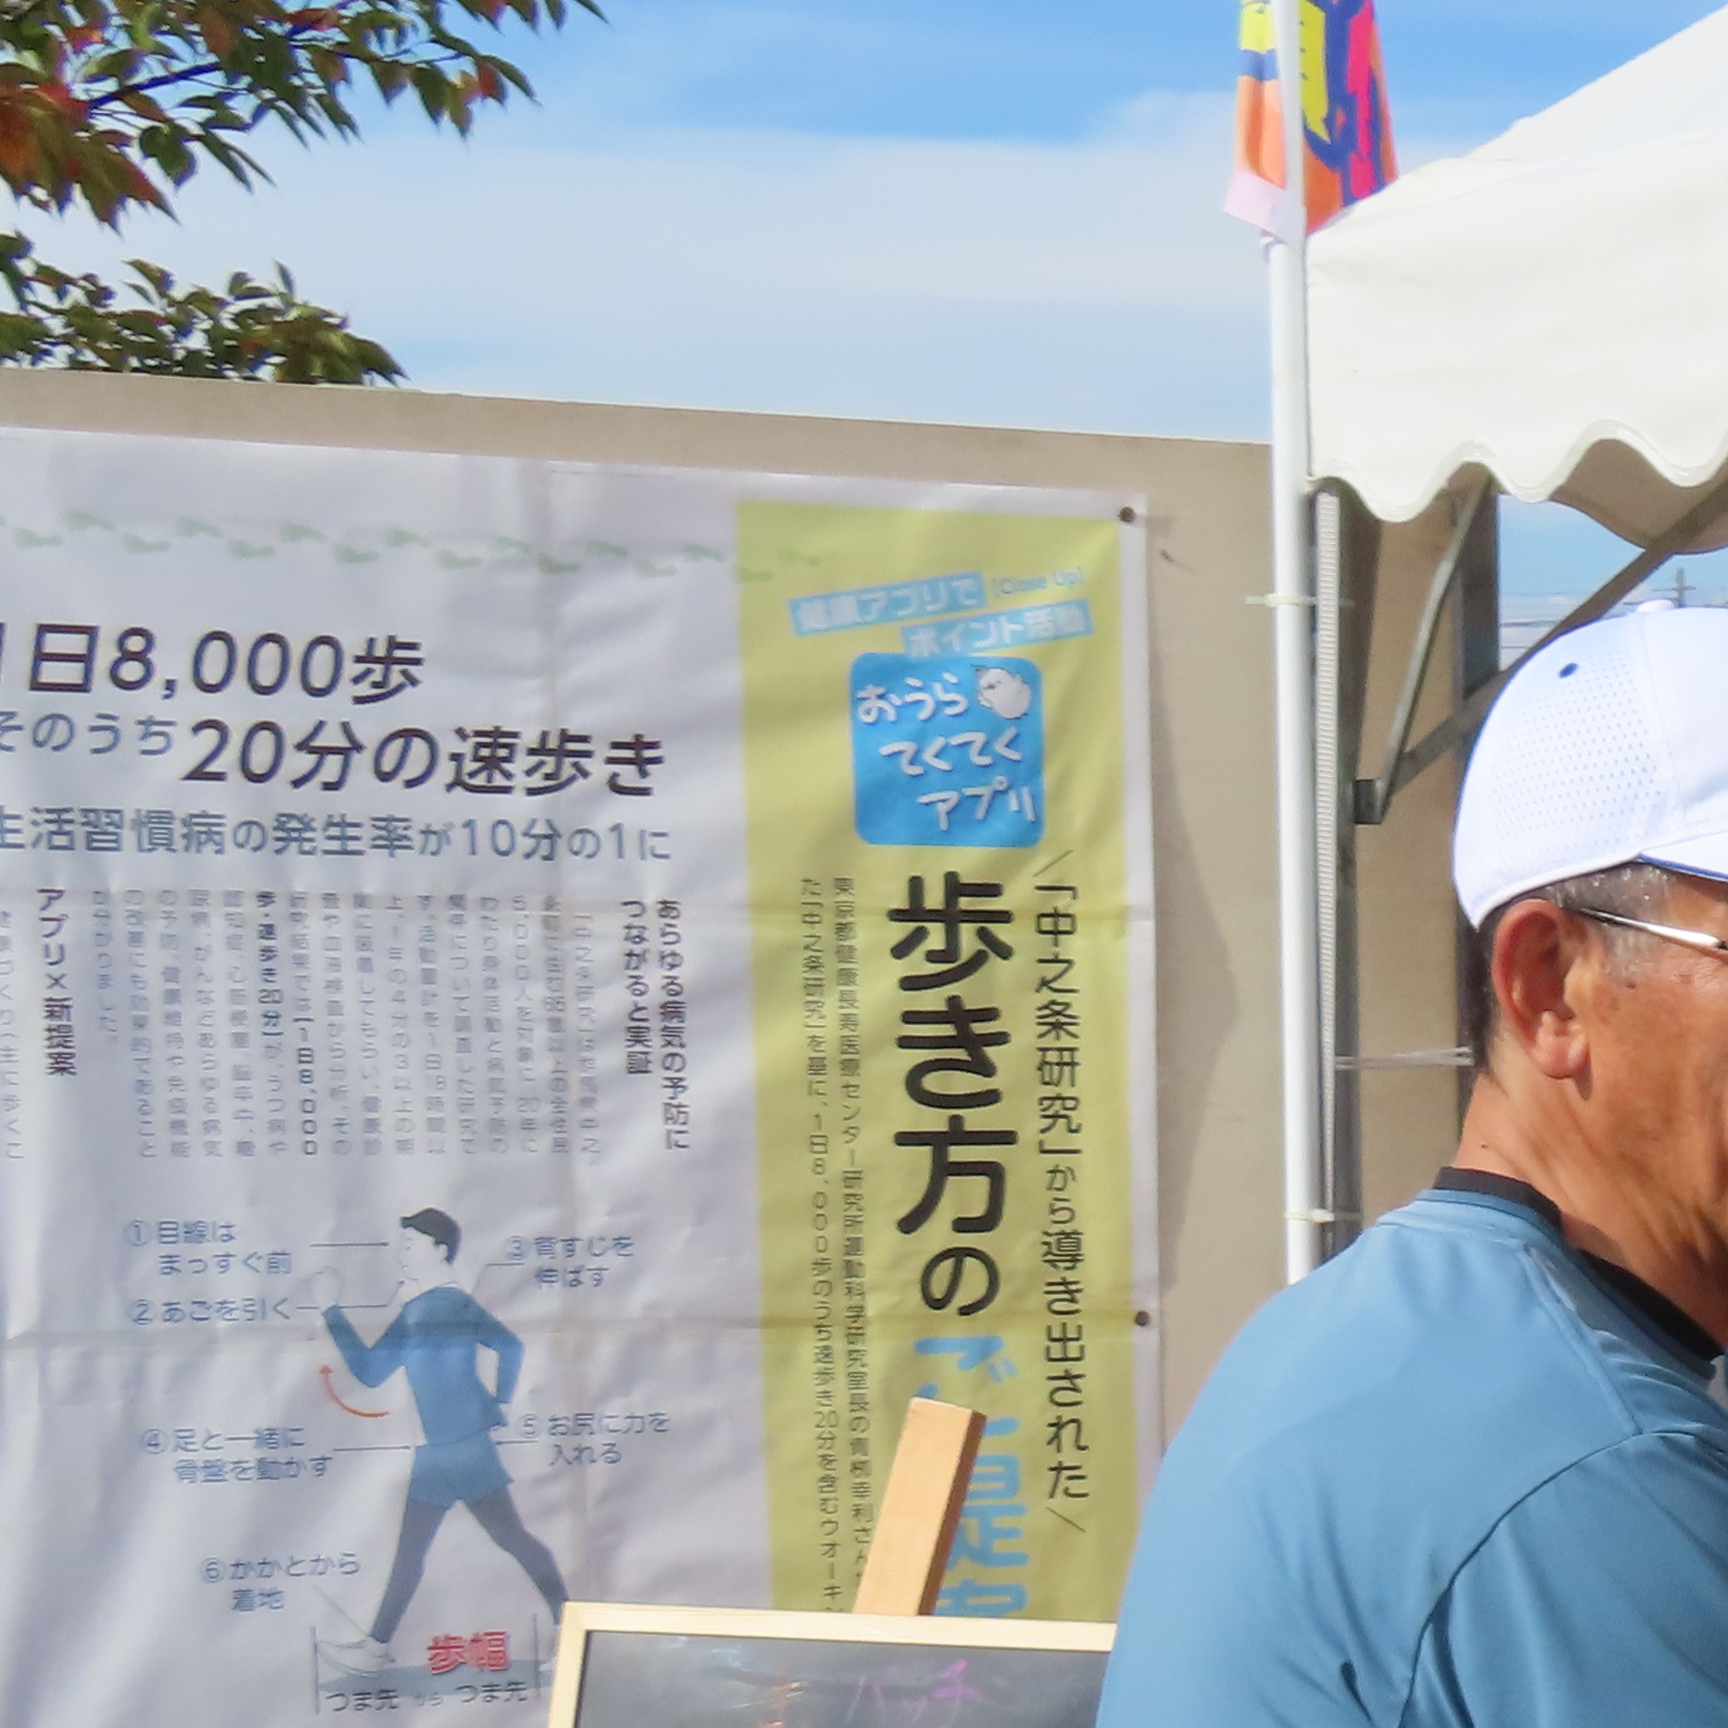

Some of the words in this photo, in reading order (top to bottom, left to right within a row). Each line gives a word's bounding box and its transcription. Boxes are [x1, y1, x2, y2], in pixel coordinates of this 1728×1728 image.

[857, 673, 969, 724] おうら
[879, 727, 1022, 776] てくてく
[917, 776, 1036, 831] アプリ
[426, 1631, 509, 1675] 歩幅
